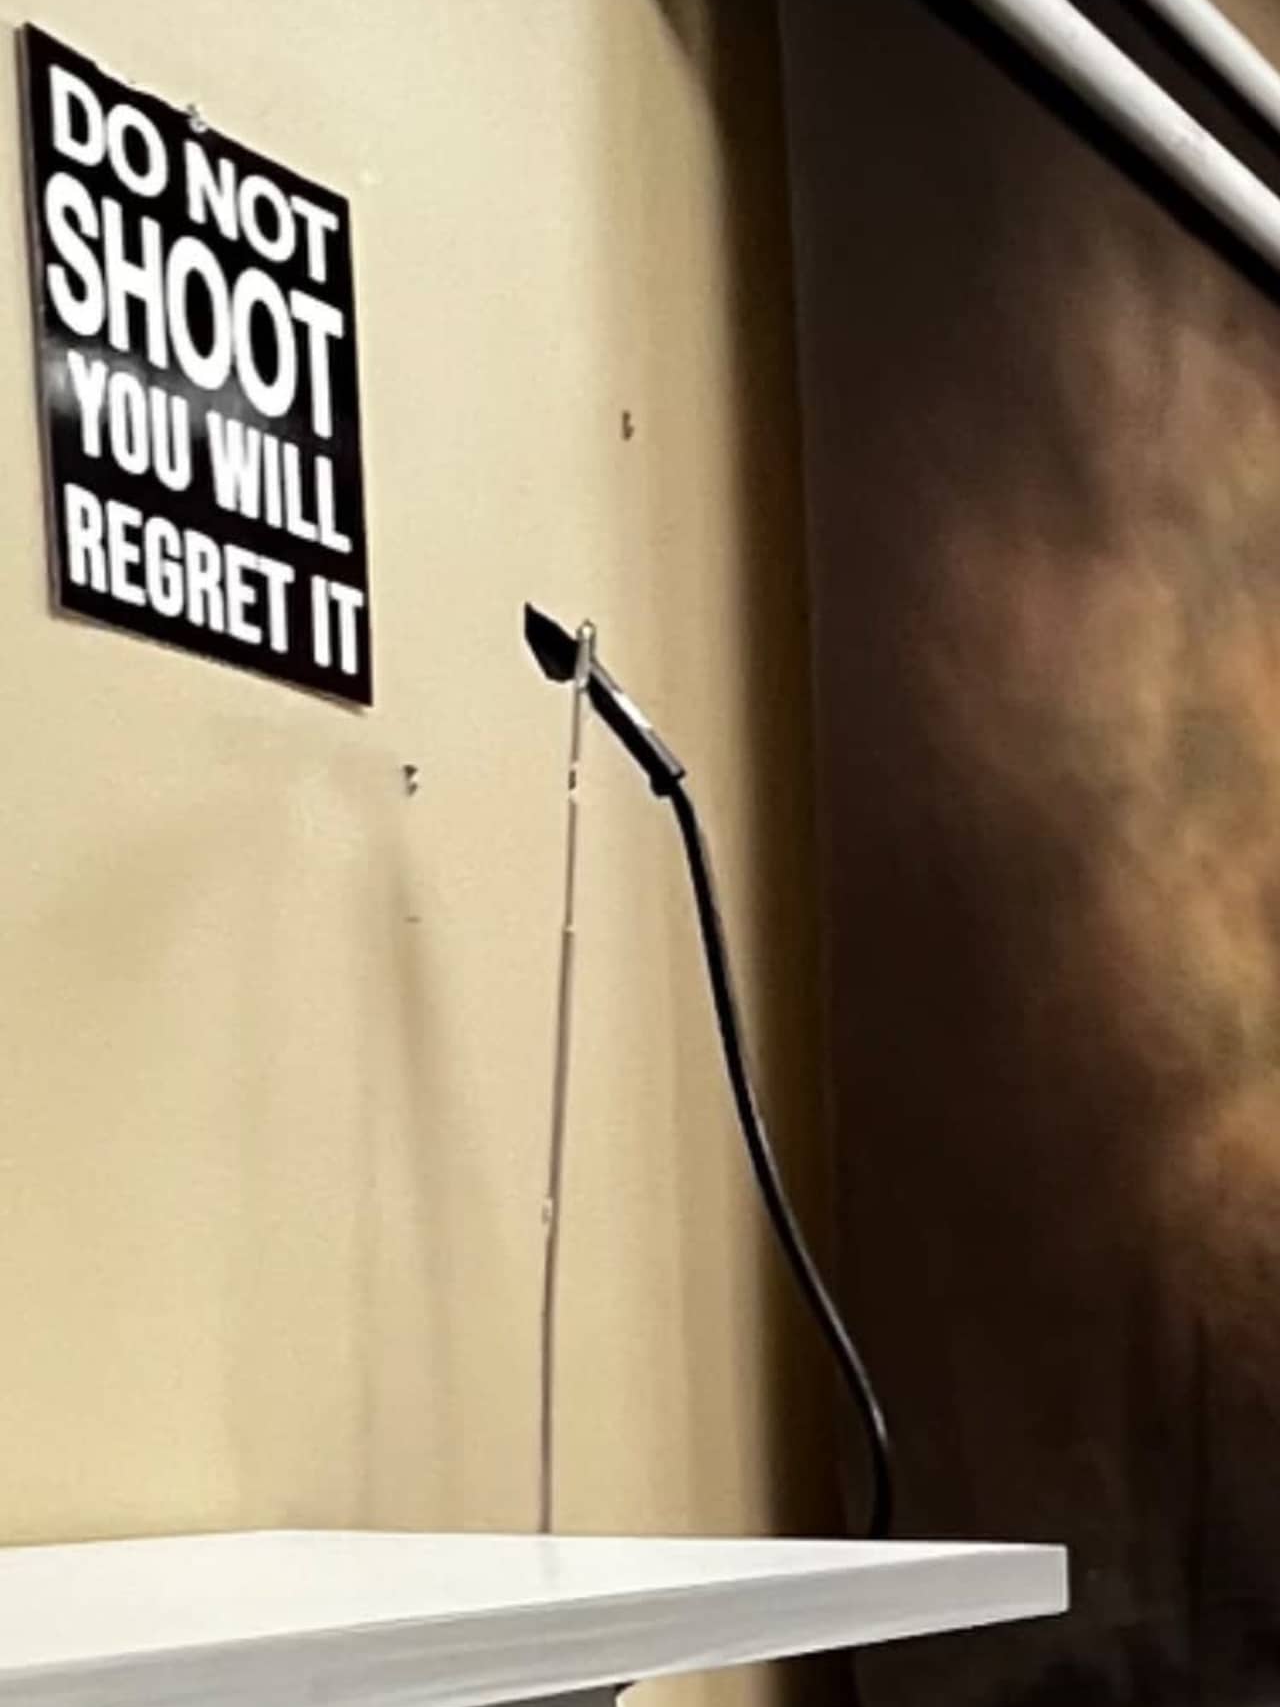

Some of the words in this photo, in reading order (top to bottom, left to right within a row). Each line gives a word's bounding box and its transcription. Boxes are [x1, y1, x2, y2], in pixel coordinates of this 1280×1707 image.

[49, 63, 167, 198] DO
[184, 137, 340, 284] NOT
[44, 170, 344, 440] SHOOT
[67, 348, 192, 493] YOU
[206, 409, 352, 554] WILL
[63, 481, 294, 655] REGRET
[311, 574, 364, 677] IT
